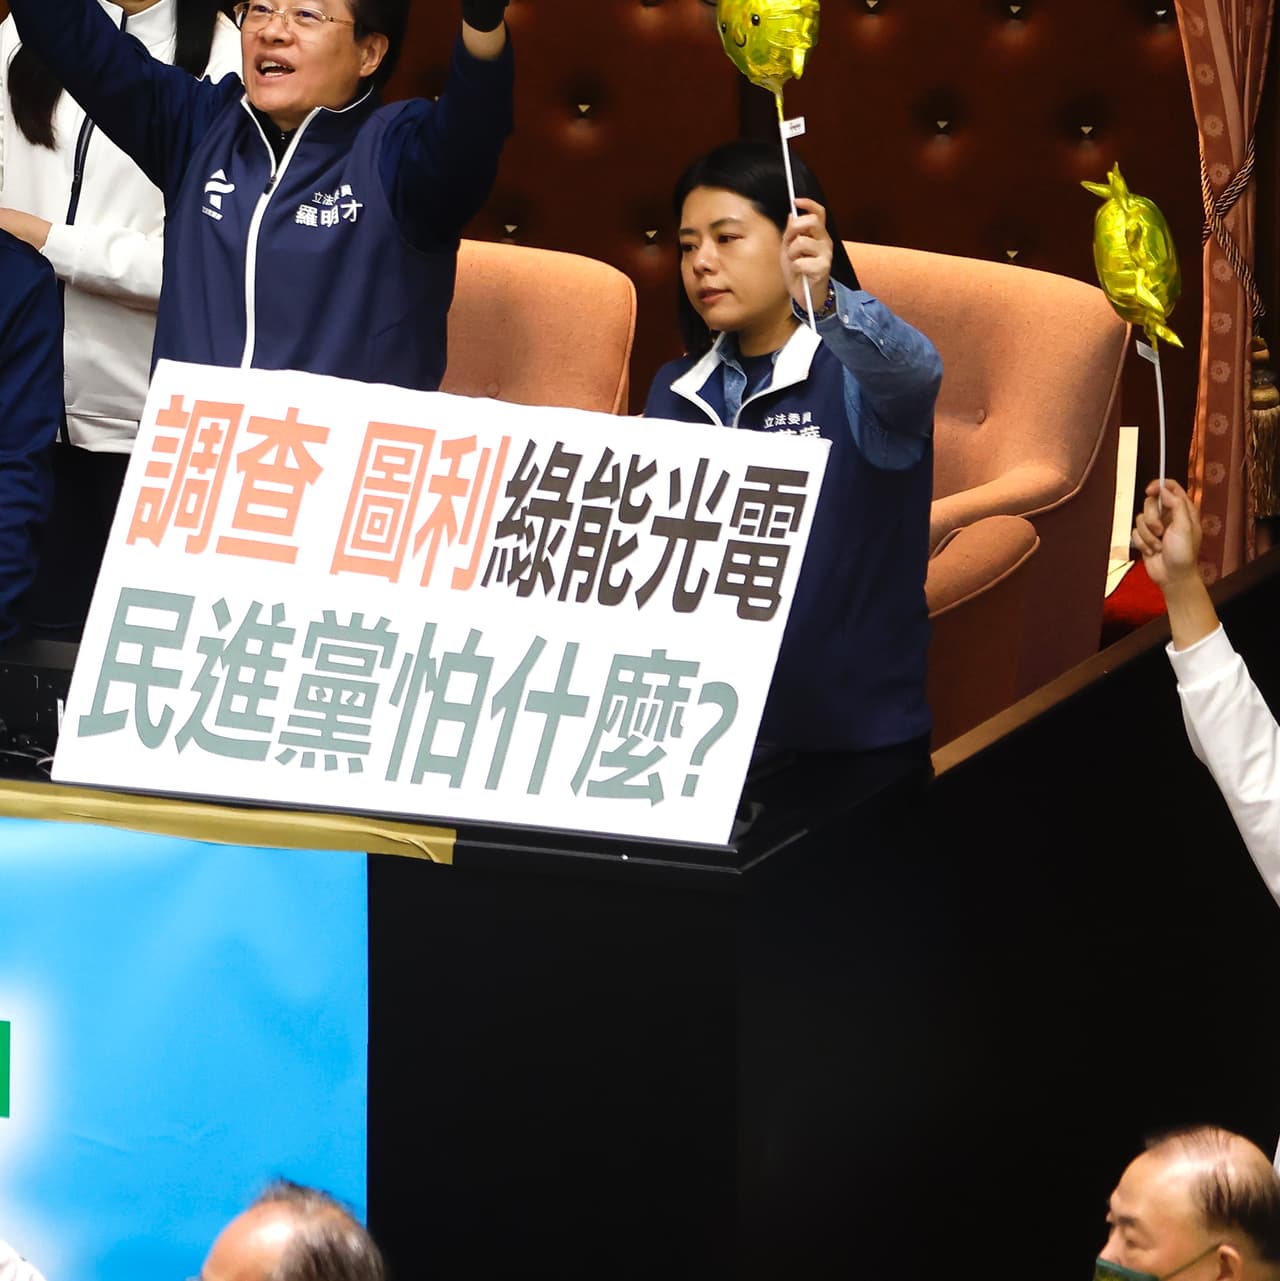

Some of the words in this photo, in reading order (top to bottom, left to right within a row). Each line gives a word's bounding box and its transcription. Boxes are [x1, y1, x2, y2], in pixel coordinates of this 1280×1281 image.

[294, 199, 364, 228] 羅明才
[763, 411, 812, 429] 立法委員
[125, 393, 325, 566] 調查
[329, 420, 812, 623] 圖利綠能光電
[77, 585, 740, 809] 民進黨怕什麼?
